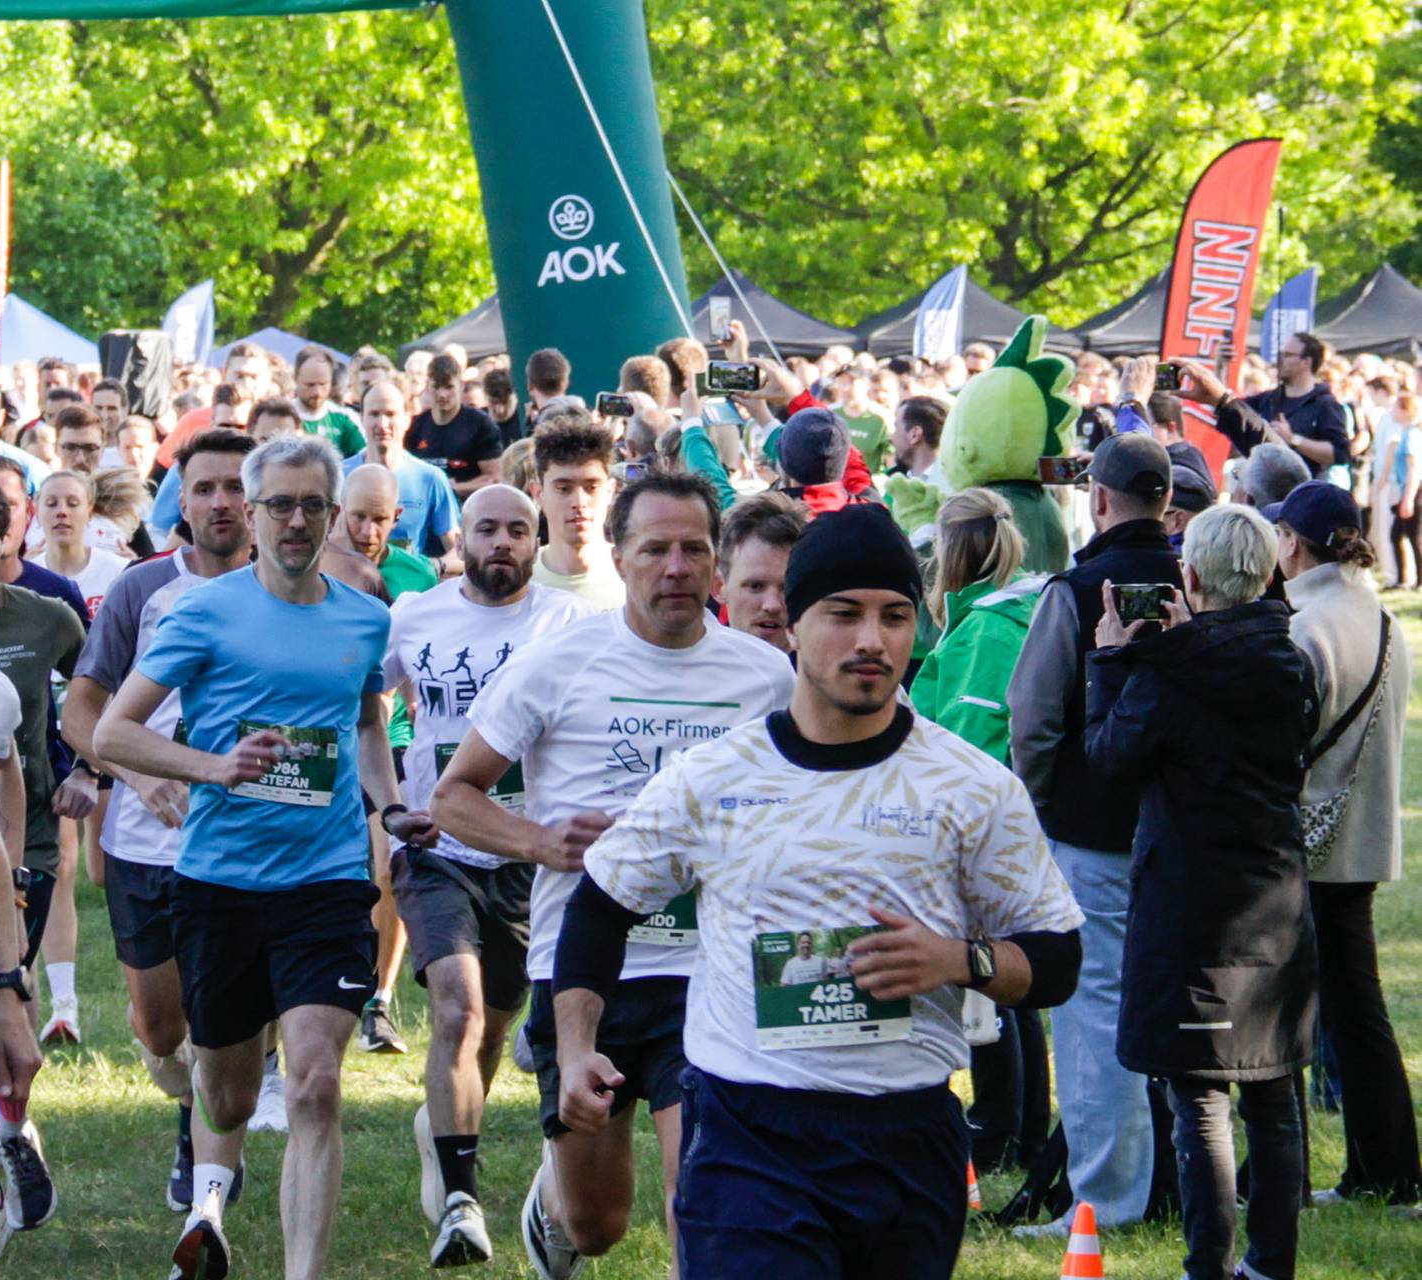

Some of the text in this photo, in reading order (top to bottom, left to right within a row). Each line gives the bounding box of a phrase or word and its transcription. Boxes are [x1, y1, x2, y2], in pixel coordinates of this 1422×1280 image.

[537, 242, 626, 287] AOK
[259, 773, 309, 789] STEFAN
[809, 983, 855, 1004] 425
[798, 1003, 868, 1024] TAMER
